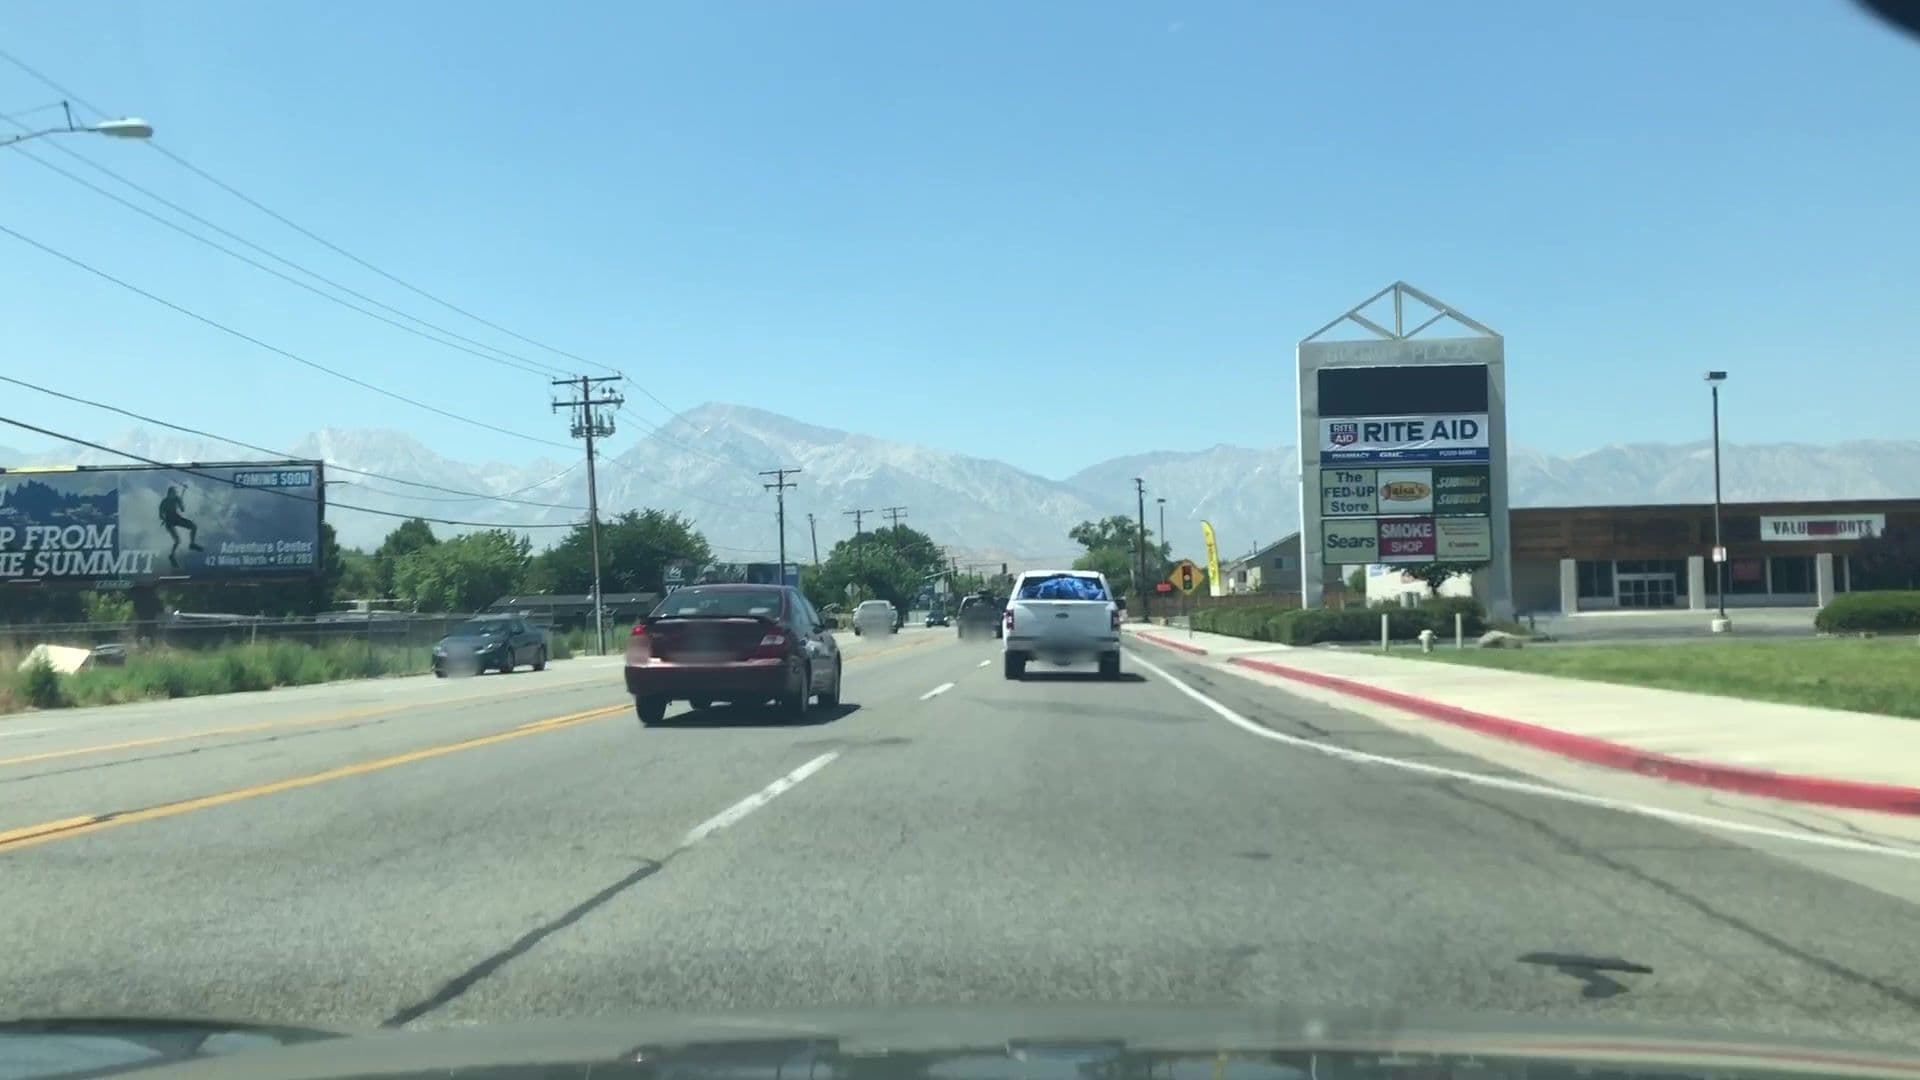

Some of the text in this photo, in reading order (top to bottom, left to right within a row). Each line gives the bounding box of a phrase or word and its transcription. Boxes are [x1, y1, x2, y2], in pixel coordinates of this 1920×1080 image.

[1333, 423, 1354, 432] RITE
[1363, 419, 1479, 443] RITE AID
[1335, 434, 1354, 443] AID
[235, 471, 310, 487] COMING SOON
[1336, 471, 1363, 483] The
[1324, 485, 1375, 498] FED-UP
[1331, 501, 1369, 513] Store
[1381, 523, 1432, 538] SMOKE
[1773, 520, 1807, 535] VALU
[22, 524, 117, 551] FROM
[1327, 534, 1376, 549] Sears
[221, 539, 312, 553] Adventure Center
[1391, 541, 1423, 552] SHOP
[32, 551, 160, 577] SUMMIT
